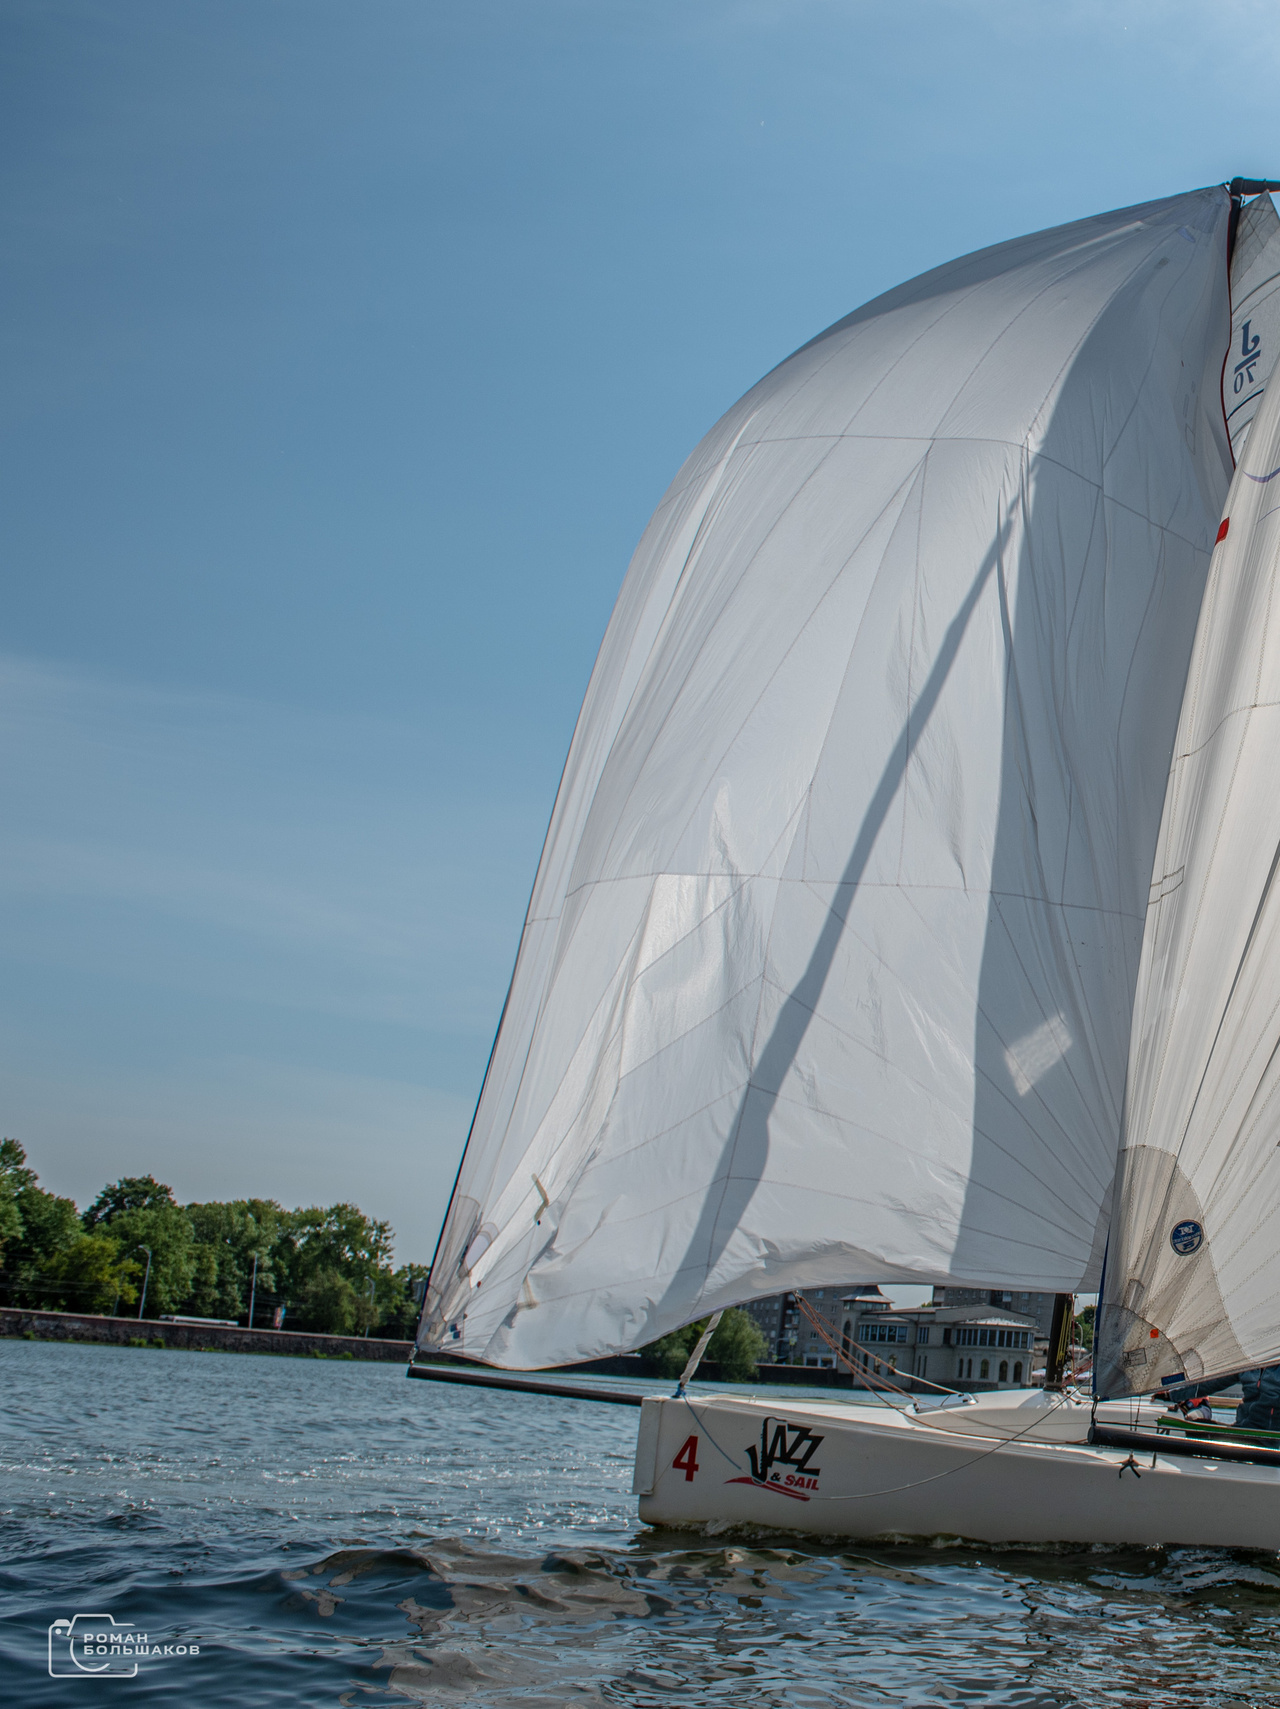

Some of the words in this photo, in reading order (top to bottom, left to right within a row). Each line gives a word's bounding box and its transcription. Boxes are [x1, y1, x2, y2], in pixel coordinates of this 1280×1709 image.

[672, 1435, 699, 1482] 4
[744, 1416, 825, 1484] JAZZ
[770, 1472, 781, 1482] &
[784, 1474, 820, 1491] SAIL
